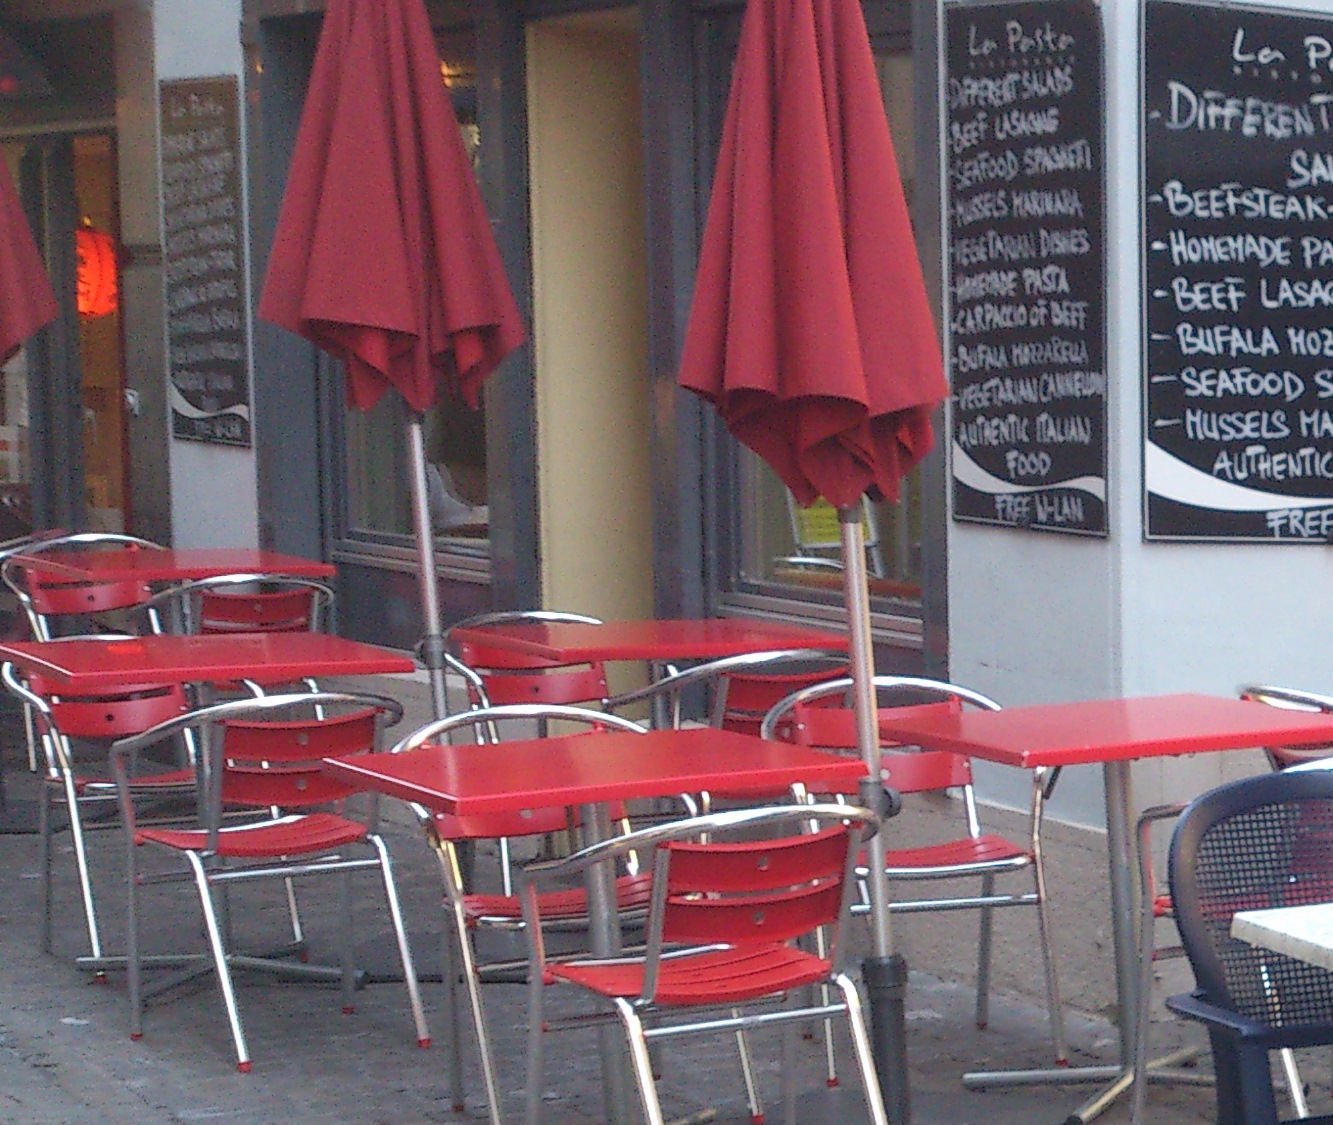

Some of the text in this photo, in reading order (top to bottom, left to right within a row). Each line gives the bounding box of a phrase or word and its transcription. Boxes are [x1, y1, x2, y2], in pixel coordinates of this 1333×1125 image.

[969, 20, 1075, 56] La Pasta
[1231, 27, 1285, 64] La
[1169, 230, 1292, 267] HOMEMADE
[1022, 264, 1070, 295] PASTA
[1172, 277, 1246, 312] BEEF
[1176, 323, 1280, 357] BUFALA
[1182, 368, 1305, 401] SEAFOOD
[1185, 408, 1291, 441] MUSSELS
[1005, 450, 1051, 479] FOOD
